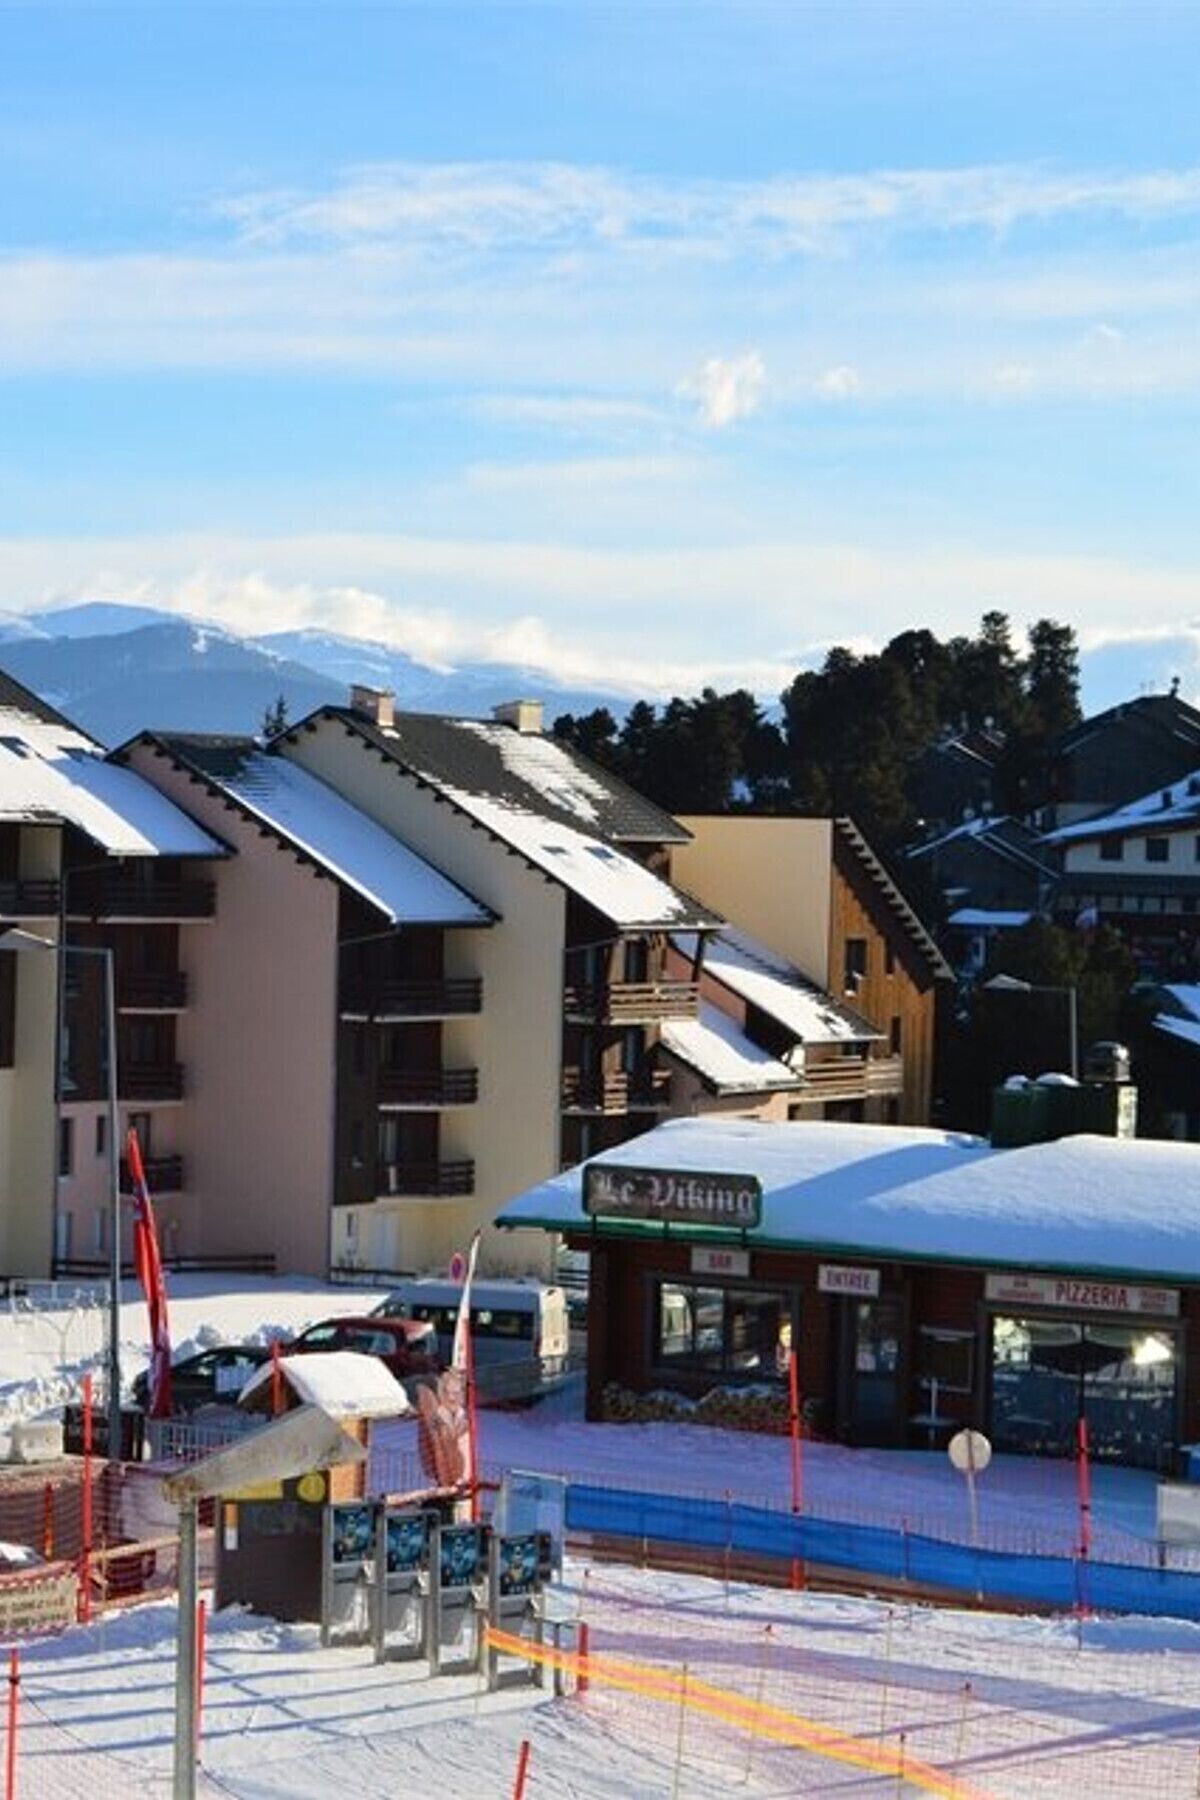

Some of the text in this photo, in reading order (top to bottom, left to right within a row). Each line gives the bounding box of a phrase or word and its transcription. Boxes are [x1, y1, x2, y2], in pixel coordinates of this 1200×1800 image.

[649, 1175, 756, 1219] Viking
[708, 1253, 732, 1267] BAR
[1055, 1281, 1129, 1308] PIZZERIA
